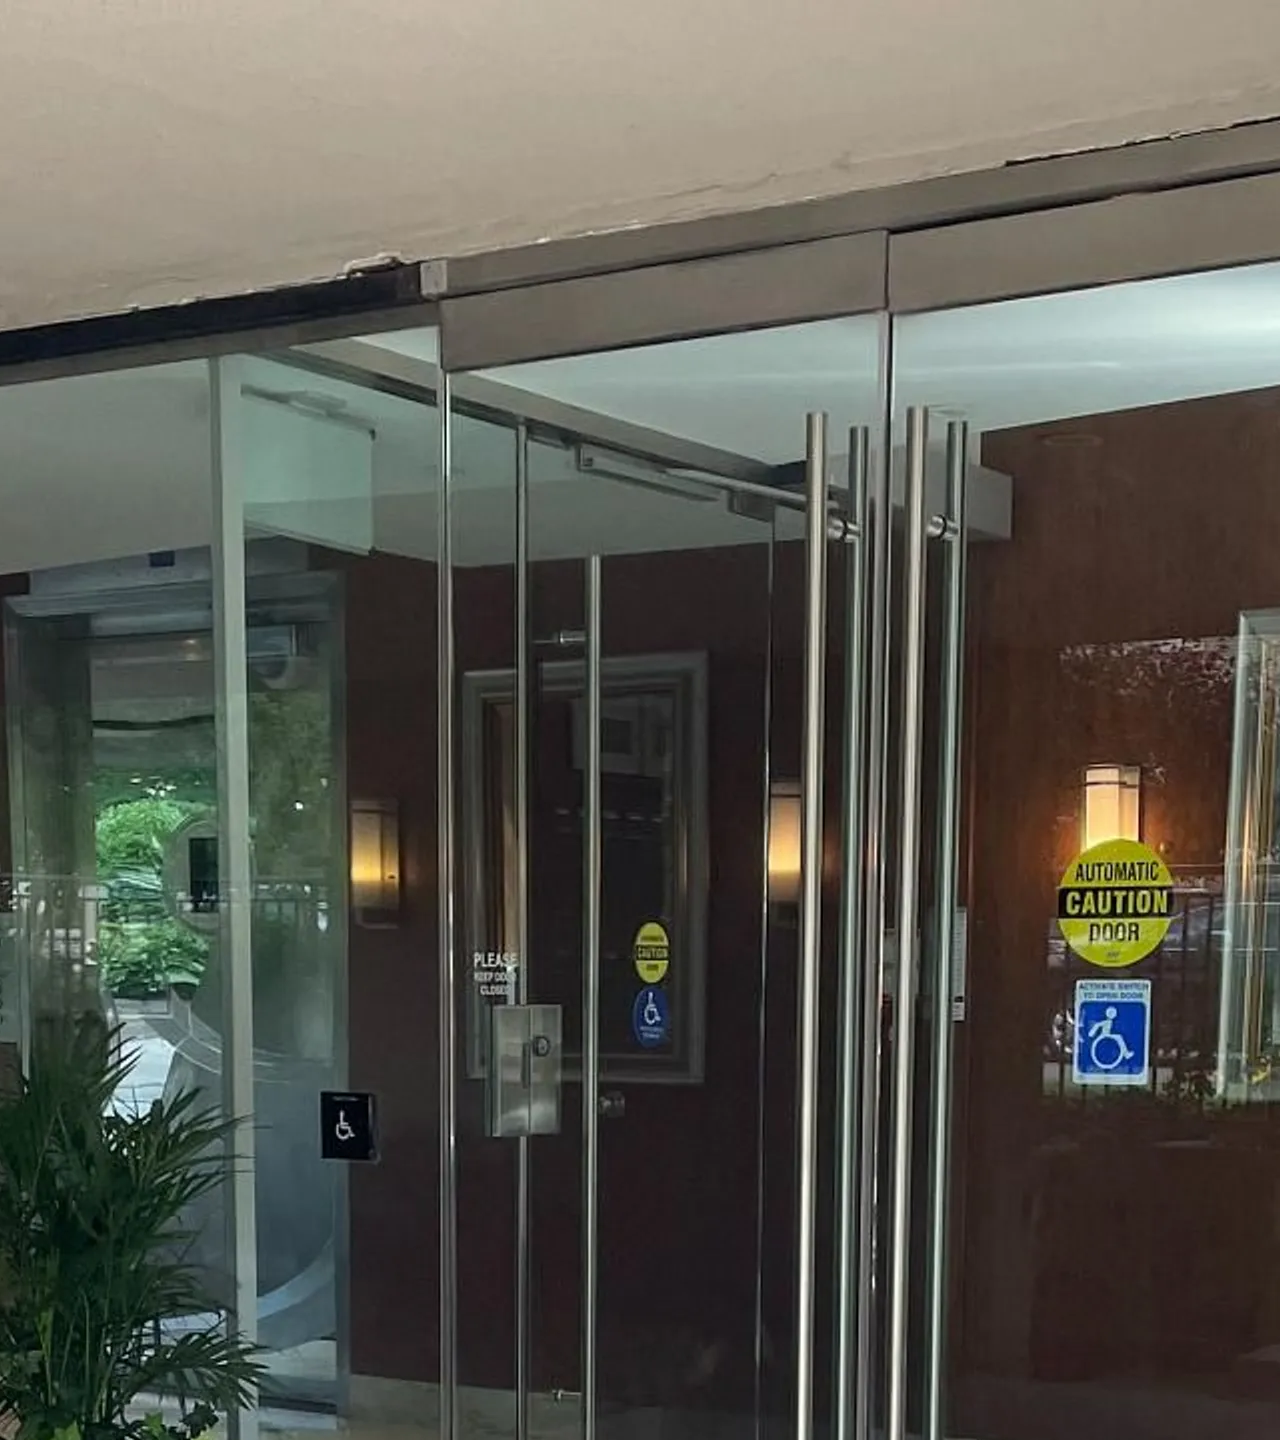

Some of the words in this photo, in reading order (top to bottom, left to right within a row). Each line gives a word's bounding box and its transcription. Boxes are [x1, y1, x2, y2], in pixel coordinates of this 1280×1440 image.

[1075, 861, 1160, 882] AUTOMATIC
[1065, 889, 1168, 916] CAUTION
[1089, 922, 1140, 943] DOOR
[473, 951, 519, 969] PLEASE
